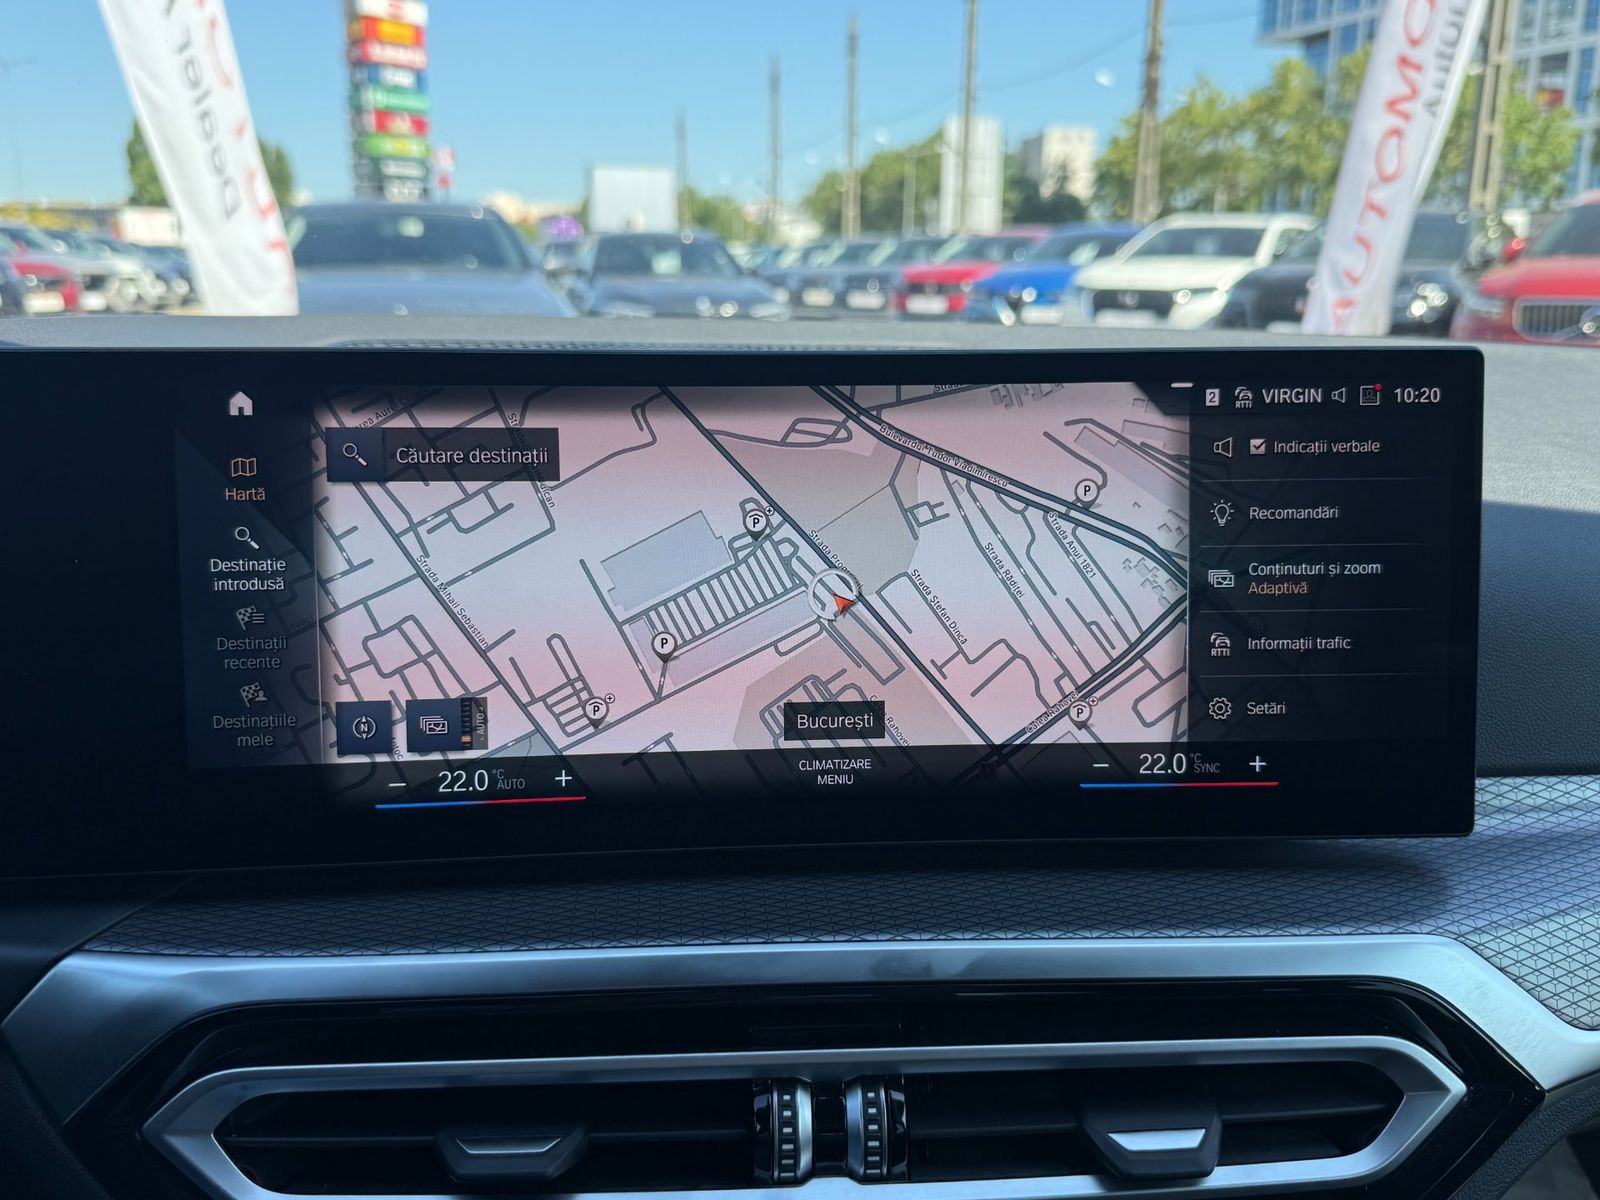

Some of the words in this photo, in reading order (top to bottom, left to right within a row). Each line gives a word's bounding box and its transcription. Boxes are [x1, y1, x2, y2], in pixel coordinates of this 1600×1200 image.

[1262, 388, 1322, 404] VIRGIN
[1394, 387, 1440, 403] 10:20
[1274, 440, 1327, 455] Indicații
[1331, 439, 1380, 453] verbale
[396, 447, 464, 464] Căutare
[469, 447, 548, 467] destinații
[879, 424, 925, 452] Bulevardul
[926, 447, 951, 464] Tudor
[953, 457, 1008, 487] Vladimirescu
[225, 487, 266, 501] Hartă
[1249, 506, 1339, 520] Recomandări
[808, 529, 831, 556] Strada
[1049, 512, 1068, 541] Strada
[1066, 540, 1082, 560] Anul
[1080, 559, 1097, 579] 1821
[984, 542, 1005, 570] Strada
[210, 558, 287, 574] Destinație
[1249, 562, 1324, 578] Conținuturi
[1328, 562, 1340, 577] și
[1344, 563, 1381, 575] zoom
[213, 576, 285, 591] introdusă
[910, 569, 932, 596] Strada
[1248, 582, 1307, 597] Adaptivă
[416, 554, 439, 583] Strada
[437, 582, 464, 610] Mihail
[456, 608, 490, 649] Sebastian
[216, 635, 287, 652] Destinații
[1248, 637, 1312, 652] Informații
[1316, 636, 1351, 650] trafic
[1211, 648, 1230, 657] RTTI
[224, 655, 281, 670] recente
[1247, 701, 1286, 715] Setări
[213, 713, 297, 730] Destinațiile
[477, 711, 485, 735] AUTO
[797, 712, 873, 731] București
[1026, 712, 1049, 733] Calea
[237, 733, 274, 747] mele
[798, 758, 872, 771] CLIMATIZARE
[1139, 753, 1187, 774] 22.0
[1193, 762, 1221, 773] SYNC
[438, 769, 489, 793] 22.0
[496, 778, 526, 790] AUTO
[817, 774, 854, 785] MENIU
